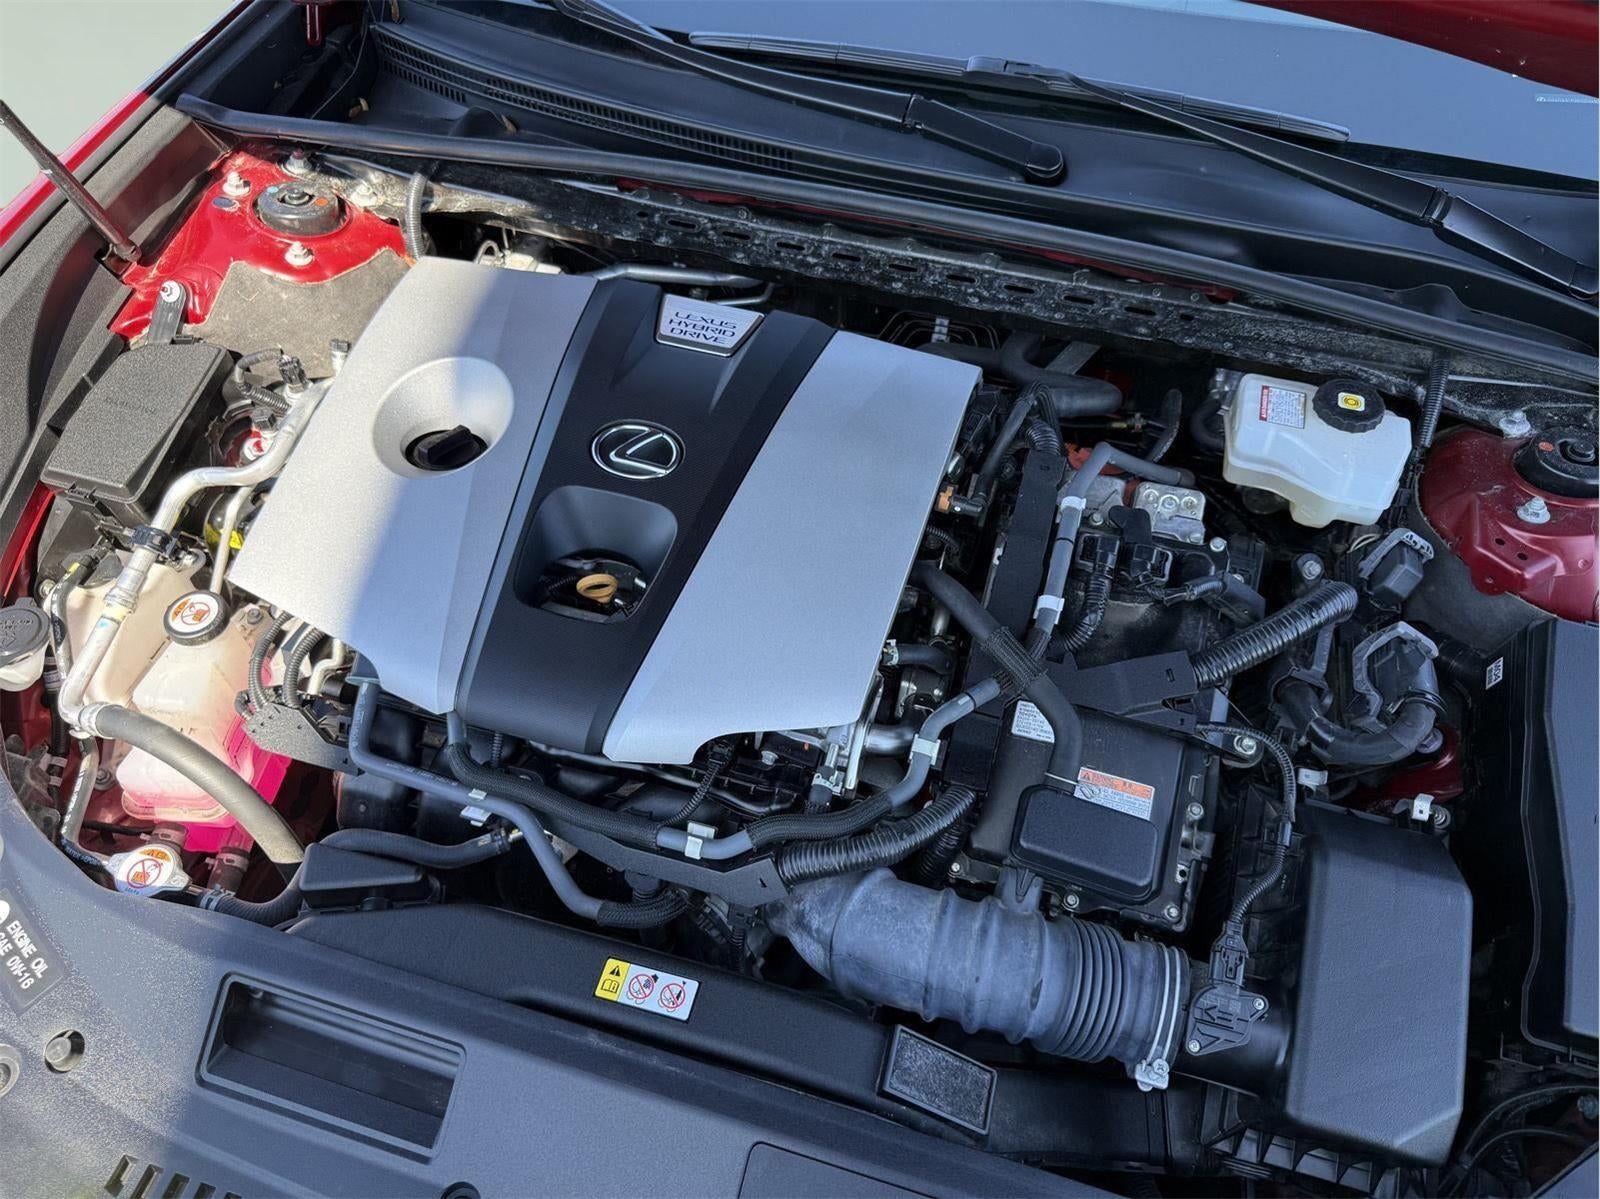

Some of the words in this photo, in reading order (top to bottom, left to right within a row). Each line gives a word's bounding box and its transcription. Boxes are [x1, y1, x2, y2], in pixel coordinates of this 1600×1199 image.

[668, 318, 735, 338] HYBRID
[675, 311, 736, 329] LEXUS
[670, 327, 726, 345] DRIVE
[6, 920, 37, 958] ENGINE
[30, 957, 48, 978] OIL
[6, 955, 35, 989] 0W-16
